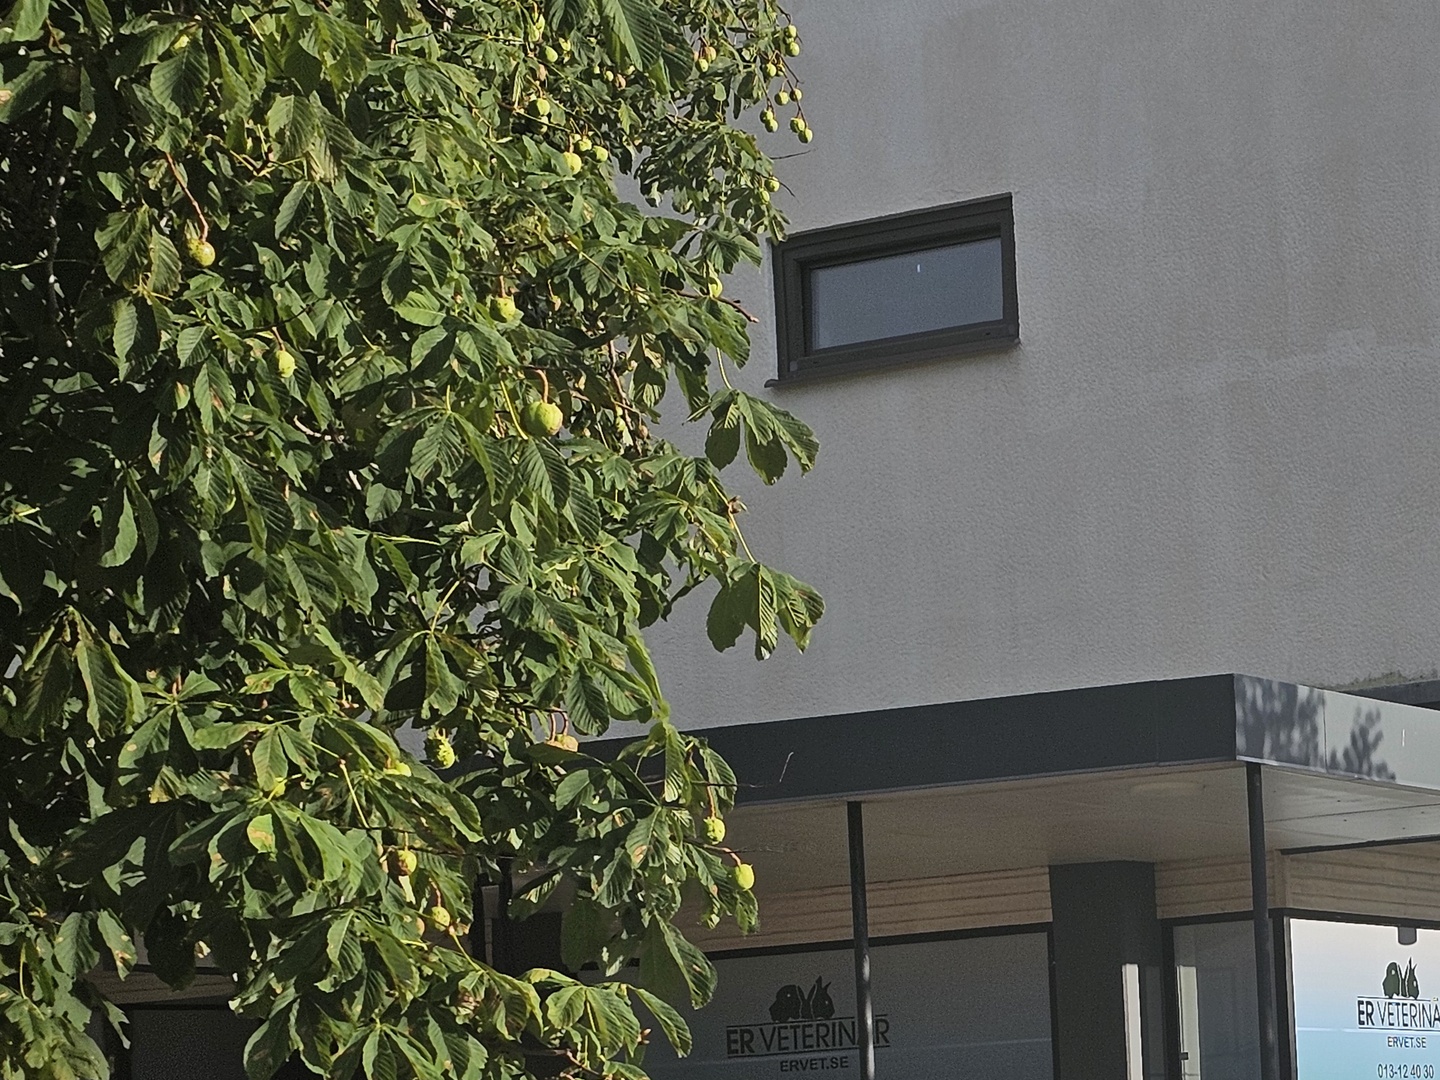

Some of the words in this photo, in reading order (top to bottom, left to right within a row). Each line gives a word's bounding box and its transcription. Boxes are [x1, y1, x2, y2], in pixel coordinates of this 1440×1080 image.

[1357, 1000, 1375, 1026] ER
[726, 1027, 755, 1055] ER
[759, 1018, 890, 1052] VETERINR
[1387, 1036, 1427, 1049] ERVET.SE
[780, 1056, 849, 1072] ERVET.SE
[1377, 1064, 1409, 1079] 013-12
[1410, 1064, 1422, 1079] 40
[1423, 1064, 1435, 1079] 30
